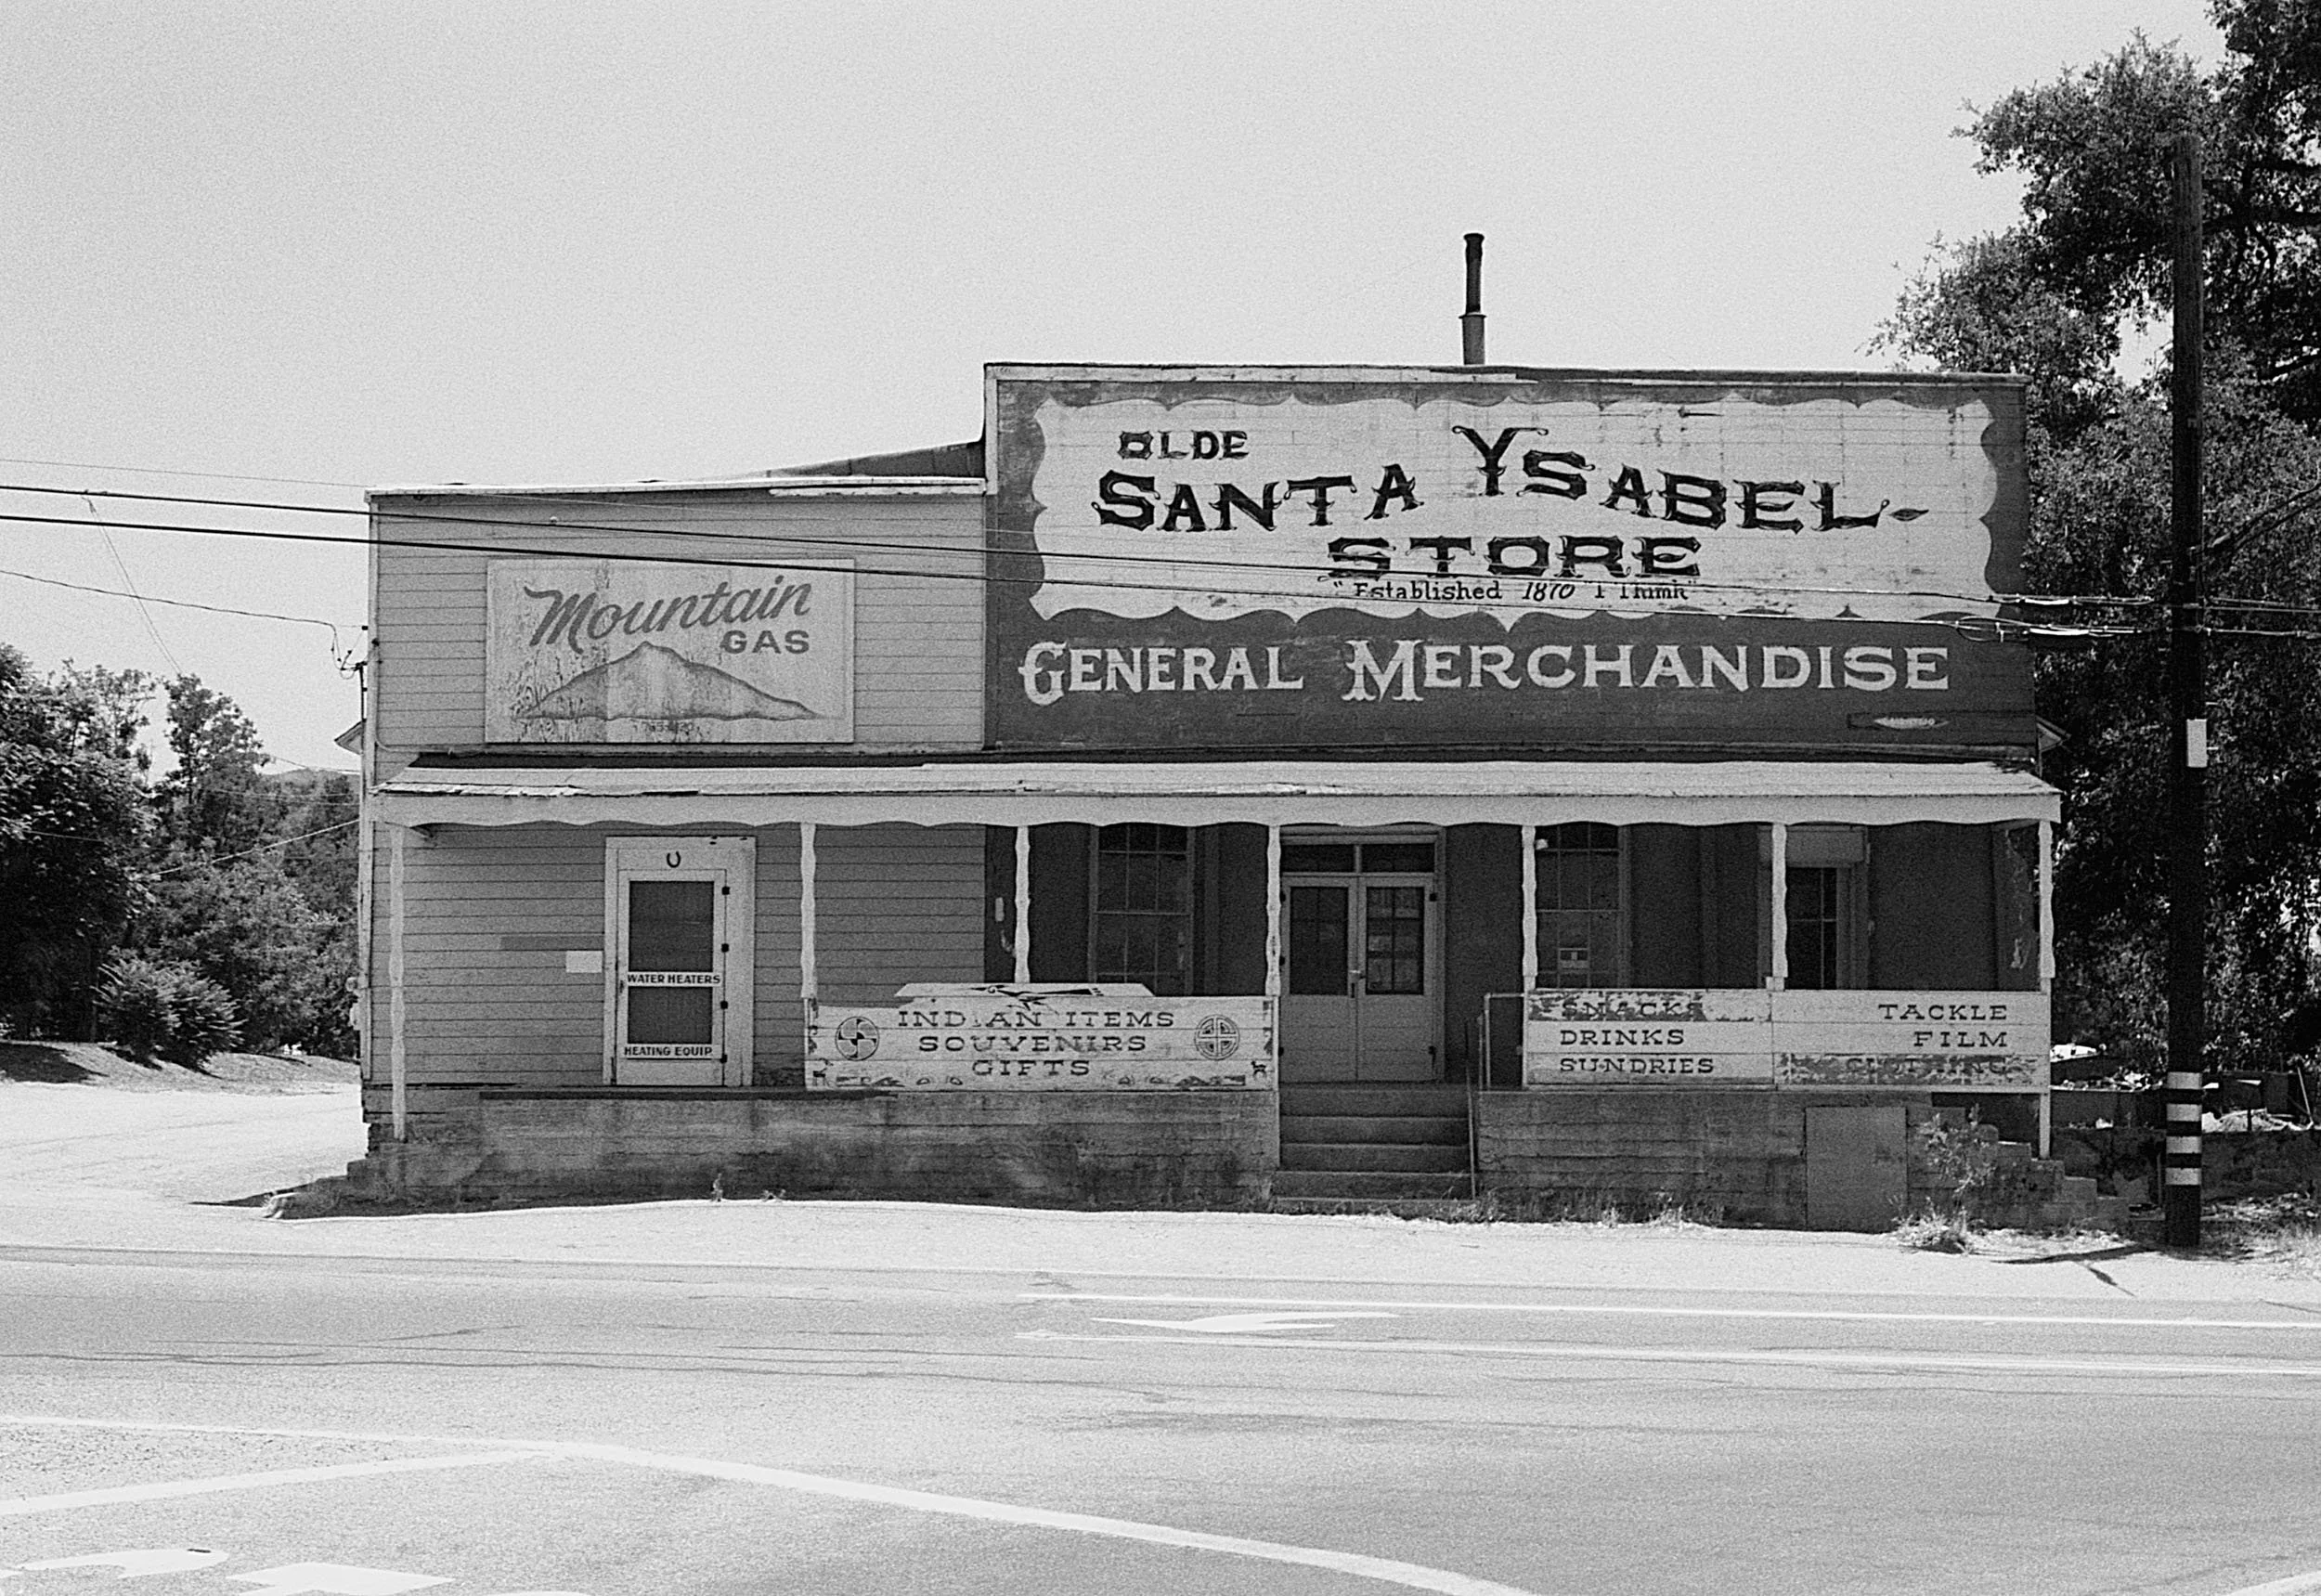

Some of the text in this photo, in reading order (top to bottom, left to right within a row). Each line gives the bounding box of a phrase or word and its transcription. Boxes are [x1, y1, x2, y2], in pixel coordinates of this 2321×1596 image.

[1118, 429, 1249, 461] OLDE
[1092, 463, 1425, 533] SANTA
[1317, 536, 1702, 581] STORE
[1522, 581, 1575, 602] 1870
[524, 575, 812, 655] Mountain
[719, 629, 810, 655] GAS
[1018, 639, 1950, 706] GENERAL MERCHANDISE
[627, 974, 721, 985] WATER HEATERS
[1067, 1011, 1174, 1028] ITEMS
[1877, 1004, 2008, 1020] TACKLE
[918, 1035, 1148, 1053] SOUVENIRS
[1560, 1029, 1685, 1046] DRINKS
[1913, 1031, 2008, 1047] FILM
[624, 1045, 671, 1057] HEATING
[972, 1059, 1091, 1077] GIFTS
[1560, 1058, 1715, 1074] SUNDRIES
